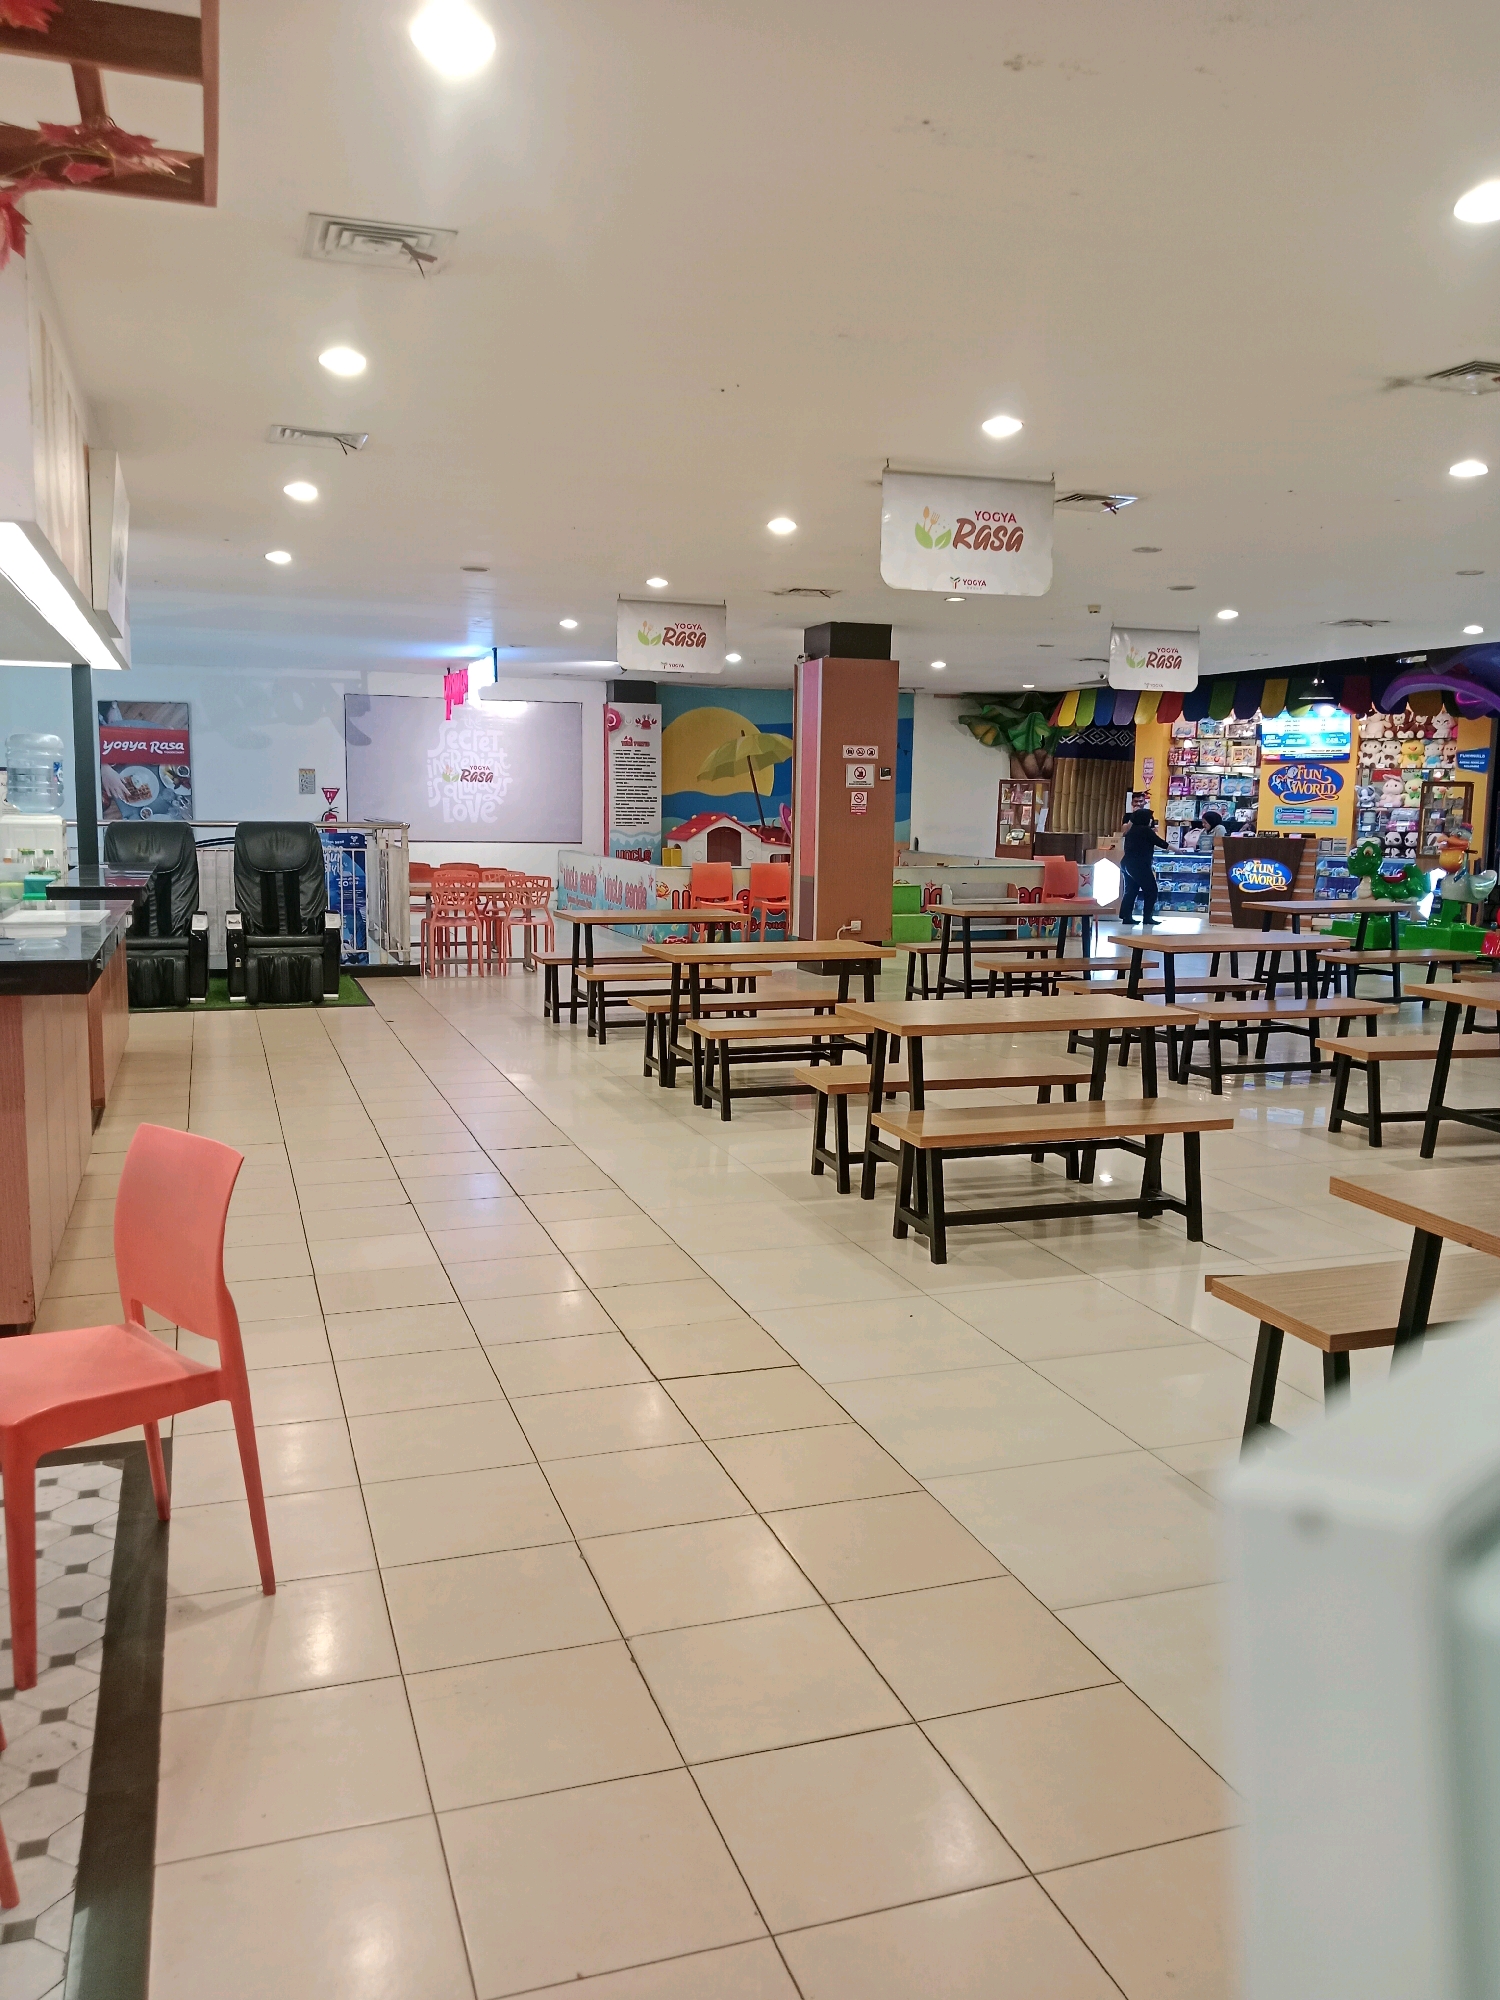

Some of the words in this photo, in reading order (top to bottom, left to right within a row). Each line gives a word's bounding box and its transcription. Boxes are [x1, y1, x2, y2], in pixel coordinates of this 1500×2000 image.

[974, 510, 1017, 524] YOGYA
[952, 517, 1024, 553] Rasa
[962, 578, 987, 587] YOGYA
[674, 622, 703, 631] YOGYA
[661, 626, 707, 649] Rasa
[1145, 651, 1183, 670] Rasa
[150, 741, 185, 754] Rasa
[460, 768, 494, 783] Rasa
